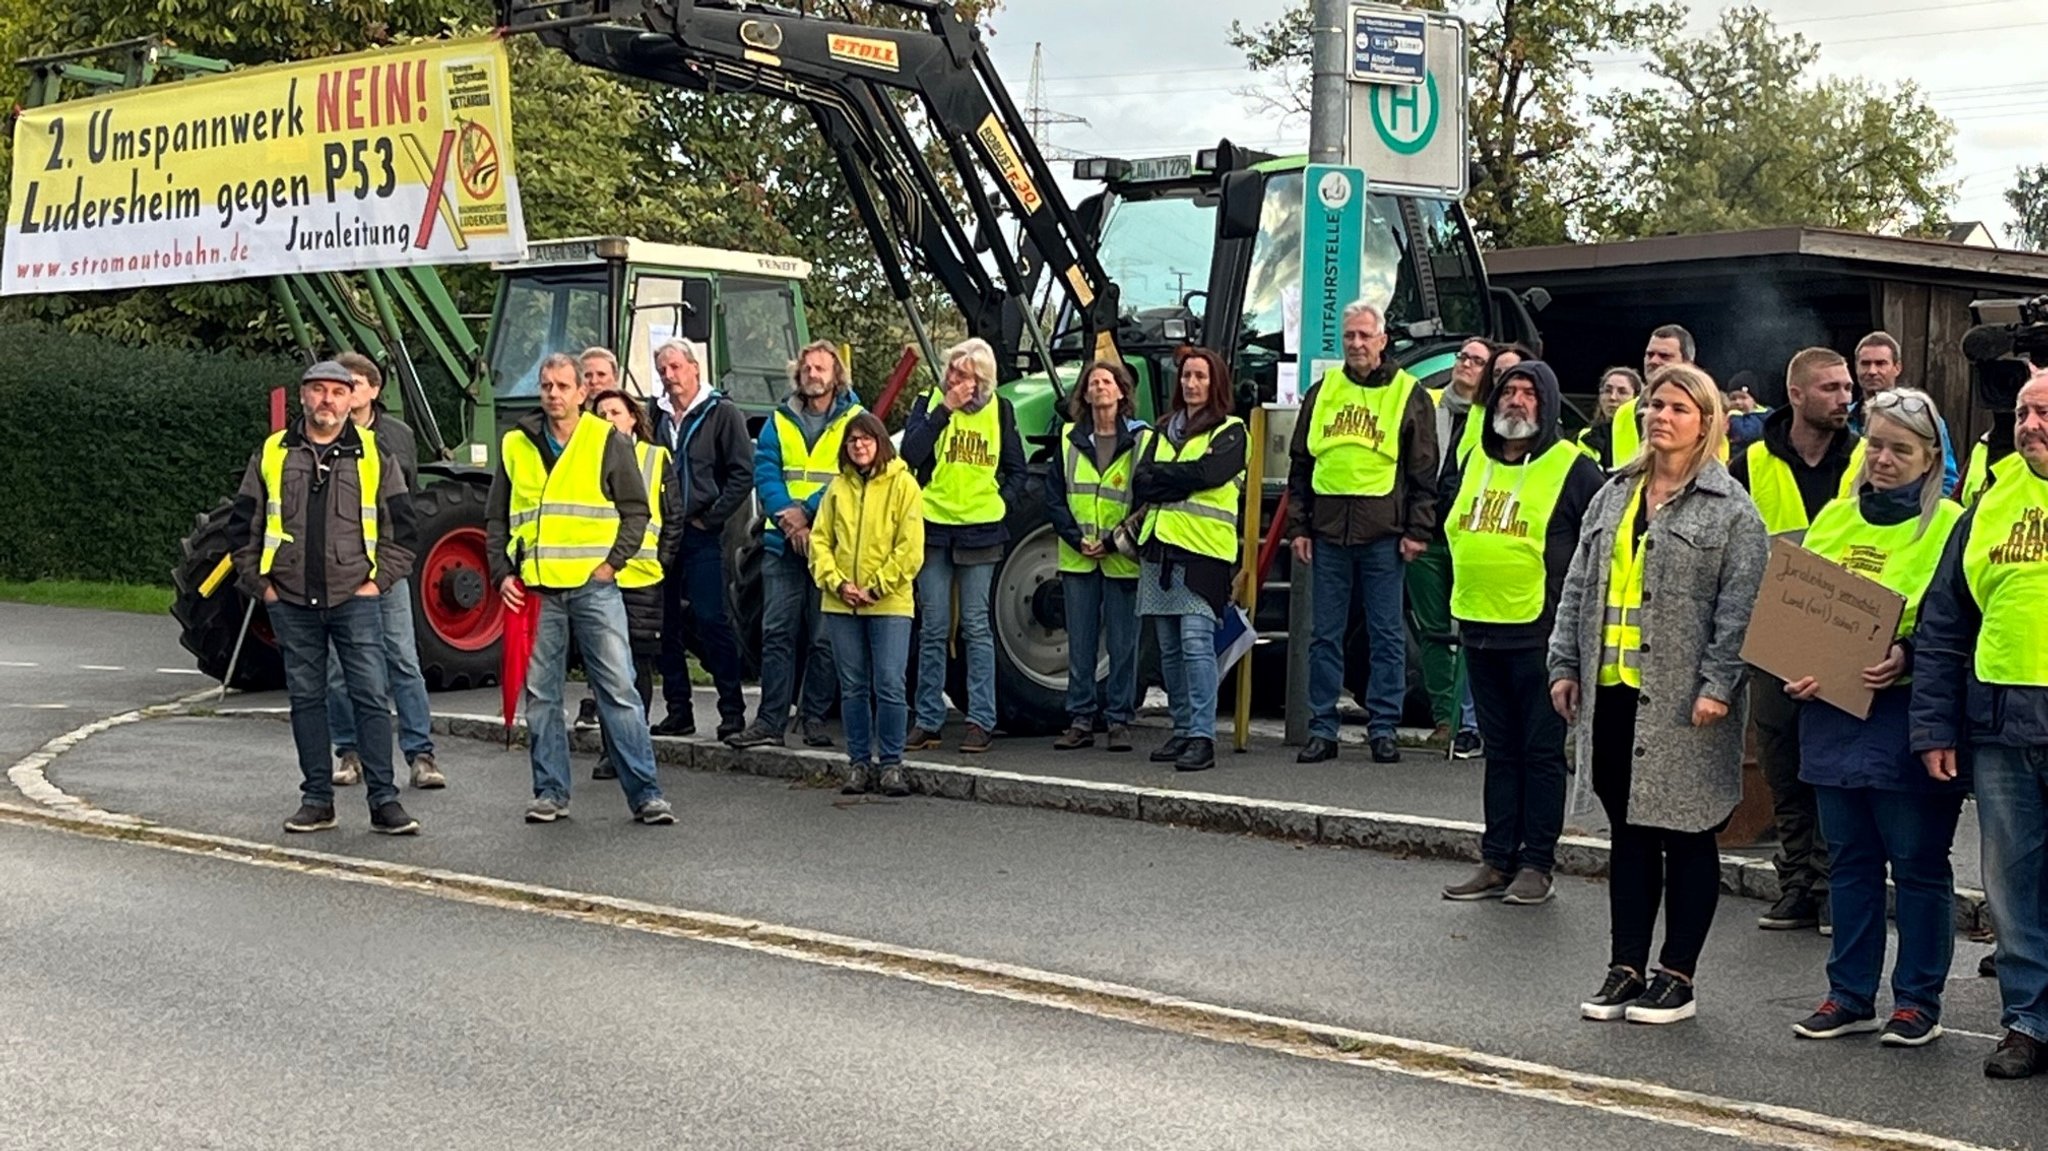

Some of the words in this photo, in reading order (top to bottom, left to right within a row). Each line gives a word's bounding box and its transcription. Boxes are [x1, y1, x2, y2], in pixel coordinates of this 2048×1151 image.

[832, 38, 895, 63] STOLL
[45, 117, 73, 171] 2.
[88, 77, 304, 170] Umspannwerk
[317, 59, 427, 133] NEIN!
[980, 126, 1016, 172] ROBUST
[20, 168, 200, 234] Ludersheim
[217, 174, 310, 229] gegen
[324, 137, 396, 203] P53
[17, 232, 249, 279] www.stromautobahn.de
[285, 212, 410, 253] Juraleitung
[757, 259, 797, 272] FENDT
[1321, 213, 1341, 353] MITFAHRSTELLE
